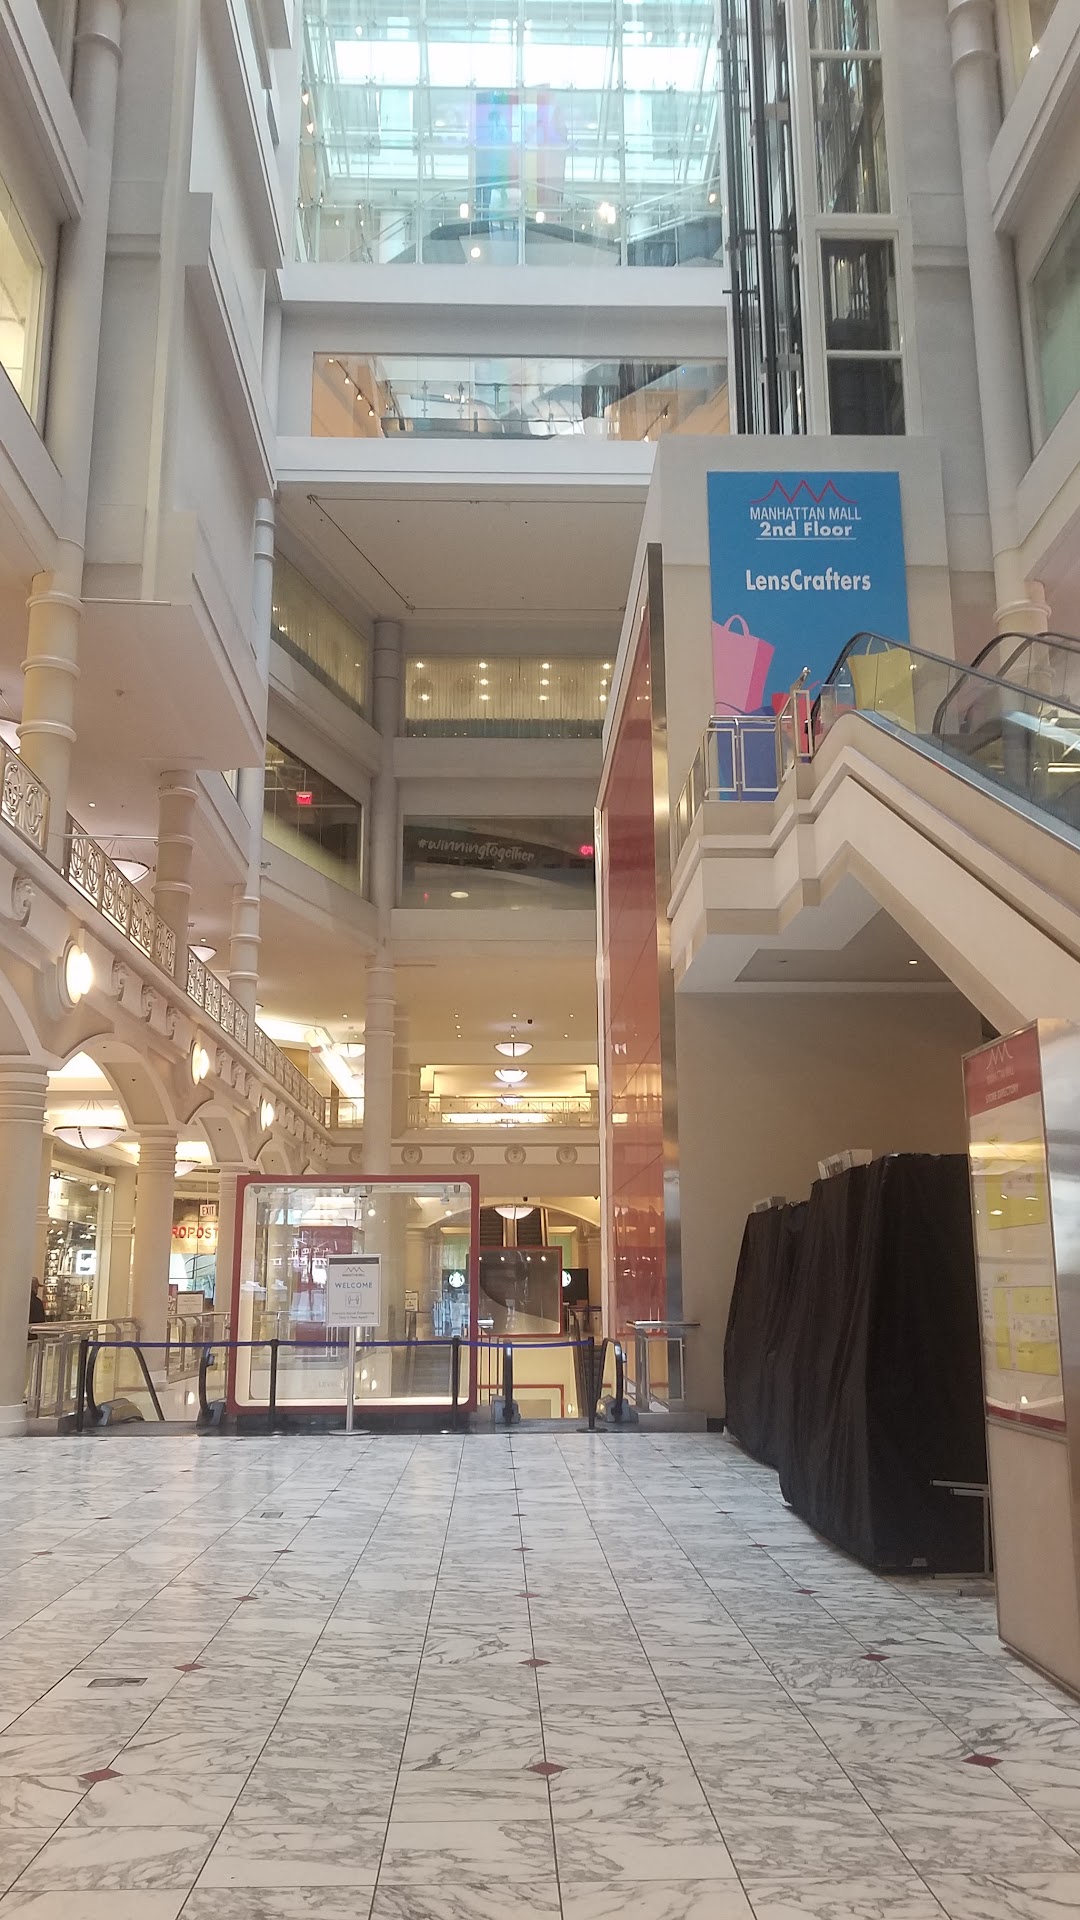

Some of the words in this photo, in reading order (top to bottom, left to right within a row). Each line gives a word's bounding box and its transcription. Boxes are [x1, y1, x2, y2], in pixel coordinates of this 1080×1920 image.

[750, 507, 825, 520] MANHATTAN
[829, 507, 861, 520] MALL
[760, 521, 796, 537] 2nd
[804, 521, 852, 537] Floor
[746, 567, 871, 590] LensCrafters
[202, 1206, 214, 1216] EXIT
